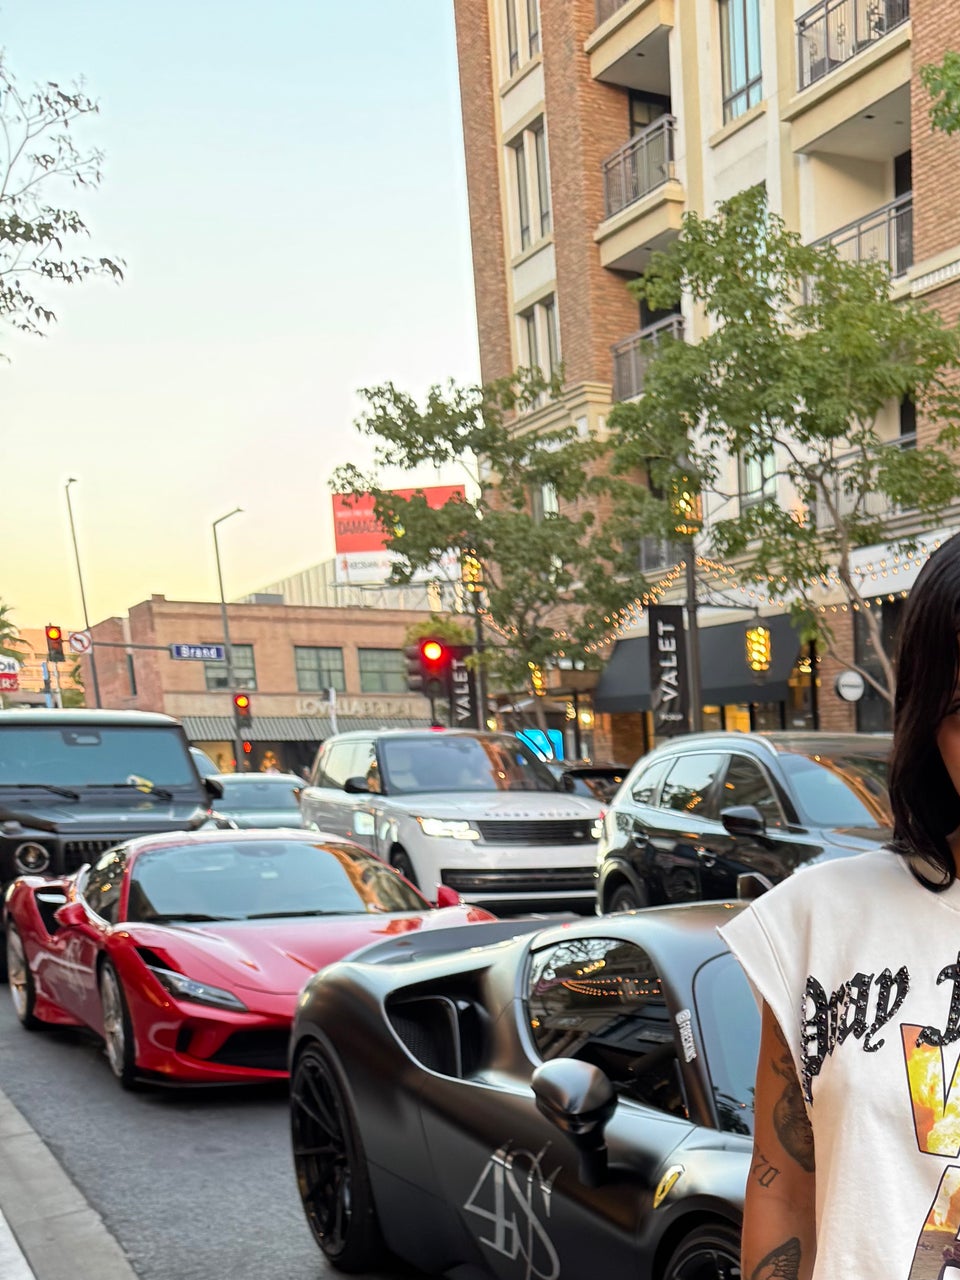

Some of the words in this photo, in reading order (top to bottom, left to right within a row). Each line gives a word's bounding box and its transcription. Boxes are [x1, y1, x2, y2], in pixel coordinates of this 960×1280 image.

[180, 645, 218, 659] Brand
[658, 620, 679, 702] VALET
[451, 658, 472, 721] VALET
